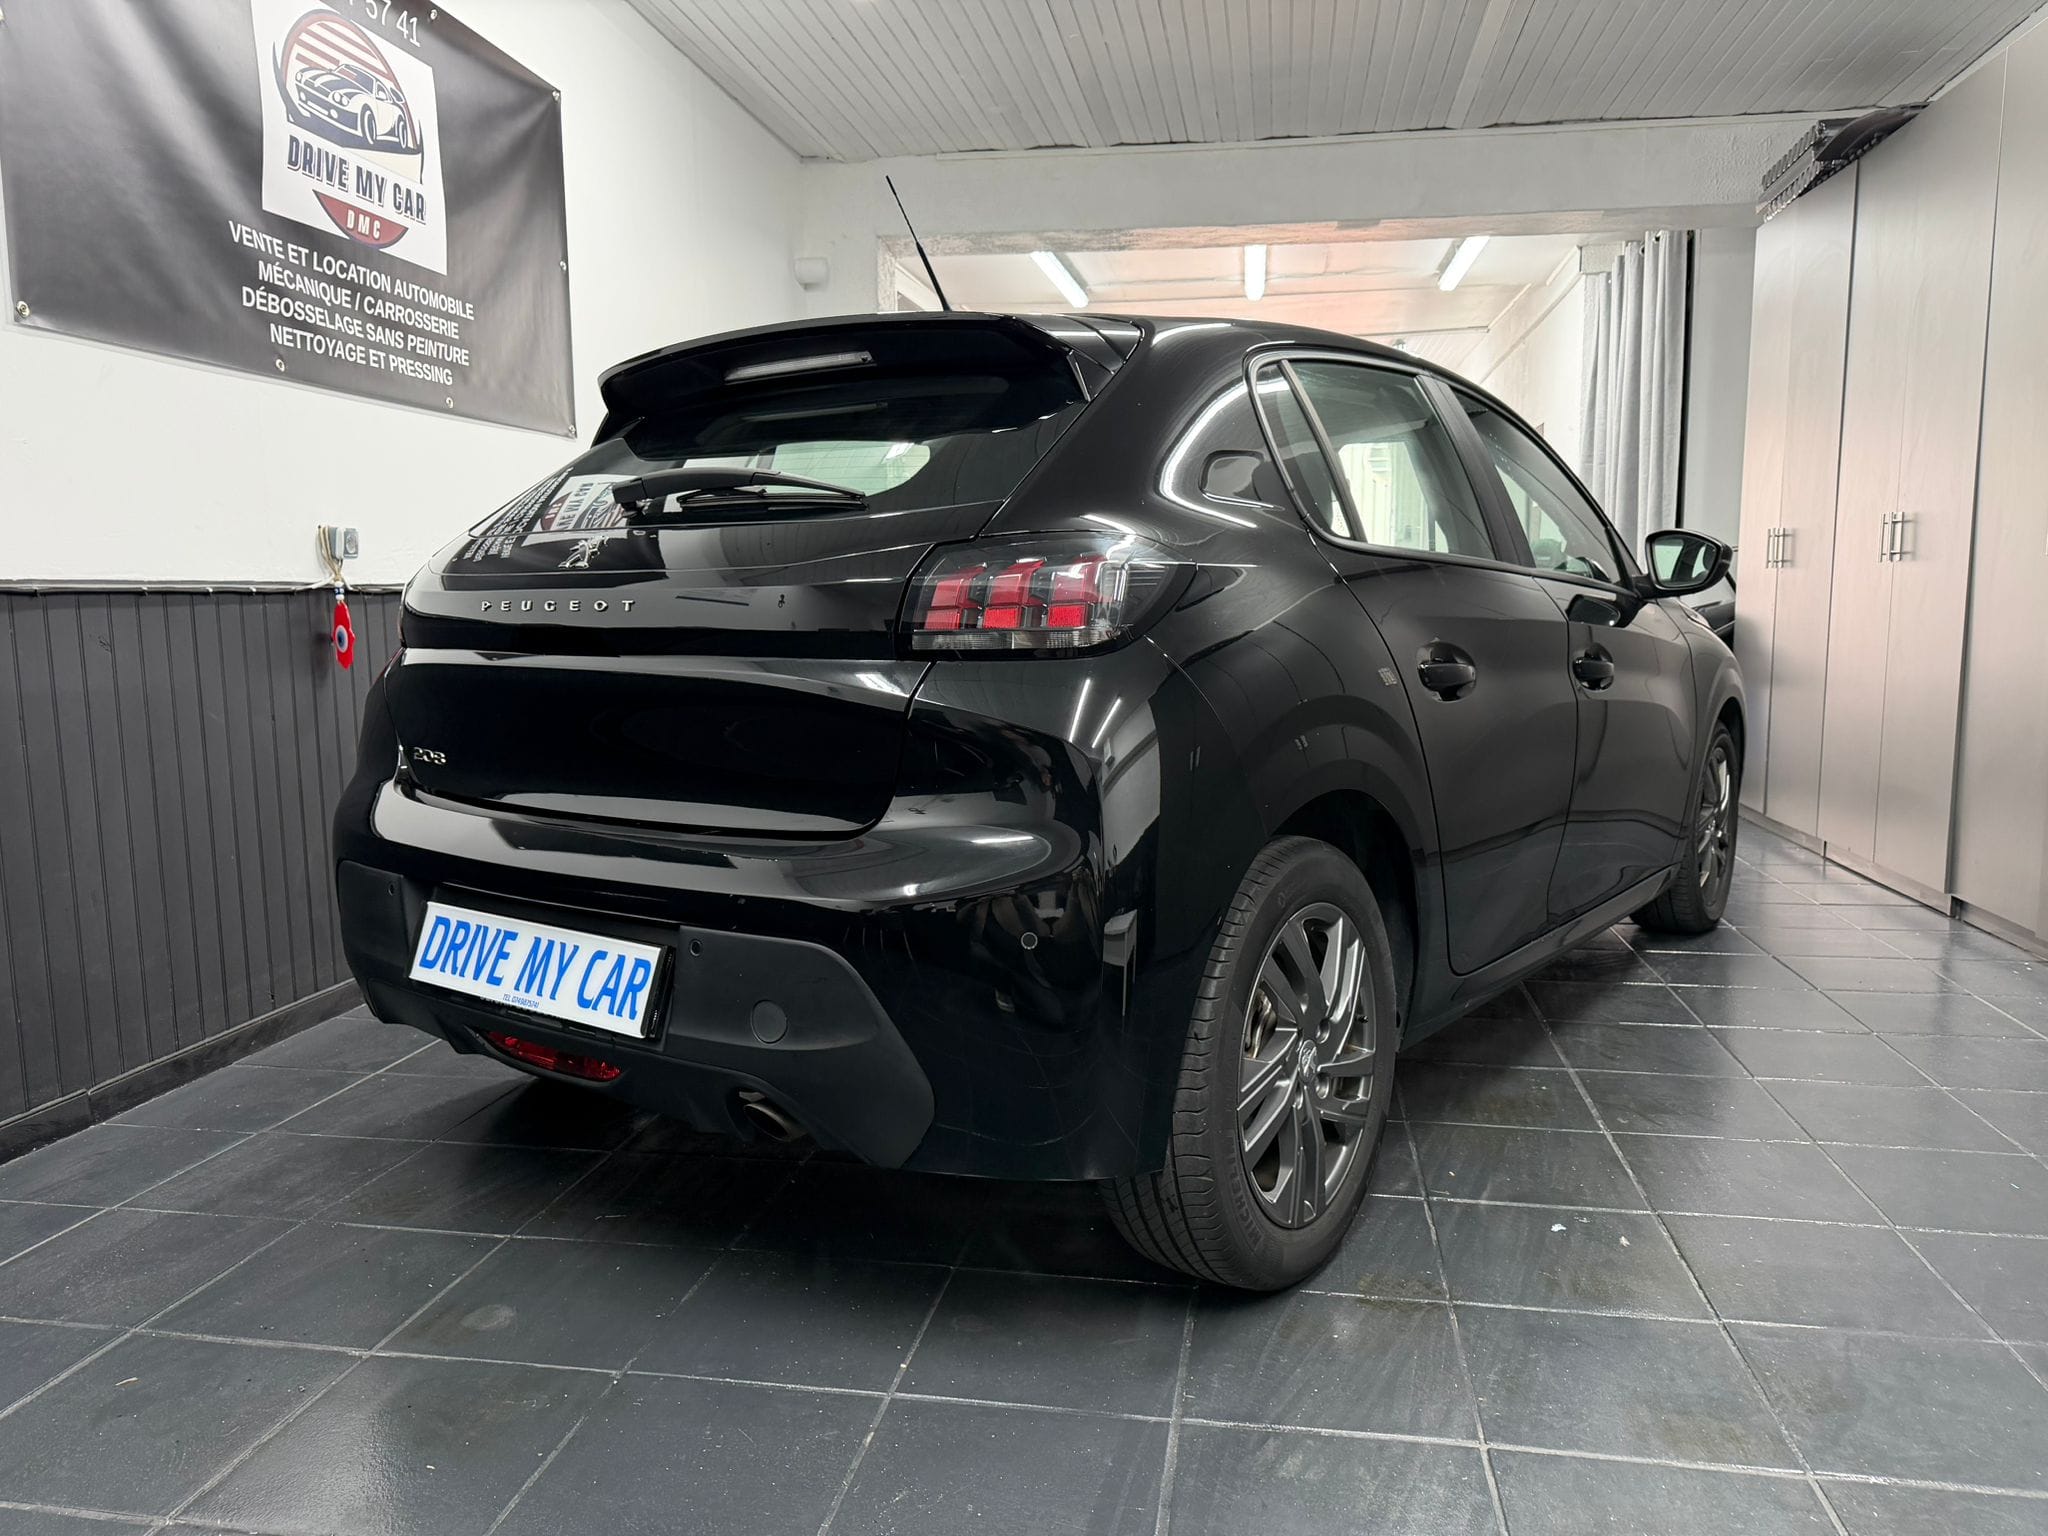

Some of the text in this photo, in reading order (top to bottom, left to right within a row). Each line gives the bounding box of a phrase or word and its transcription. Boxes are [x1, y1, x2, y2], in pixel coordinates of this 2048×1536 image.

[396, 10, 421, 47] 41
[287, 134, 426, 225] DRIVE MY CAR
[228, 221, 475, 320] VENTE ET LOCATION AUTOMOBILE
[258, 261, 352, 310] MÉCANIQUE
[364, 296, 459, 339] CARROSSERIE
[242, 286, 470, 366] DÉBOSSELAGE SANS PEINTURE
[270, 323, 453, 385] NETTOYAGE ET PRESSING
[481, 600, 635, 612] PEUGEOT
[413, 746, 447, 765] 208
[419, 915, 651, 1020] DRIVE MY CAR
